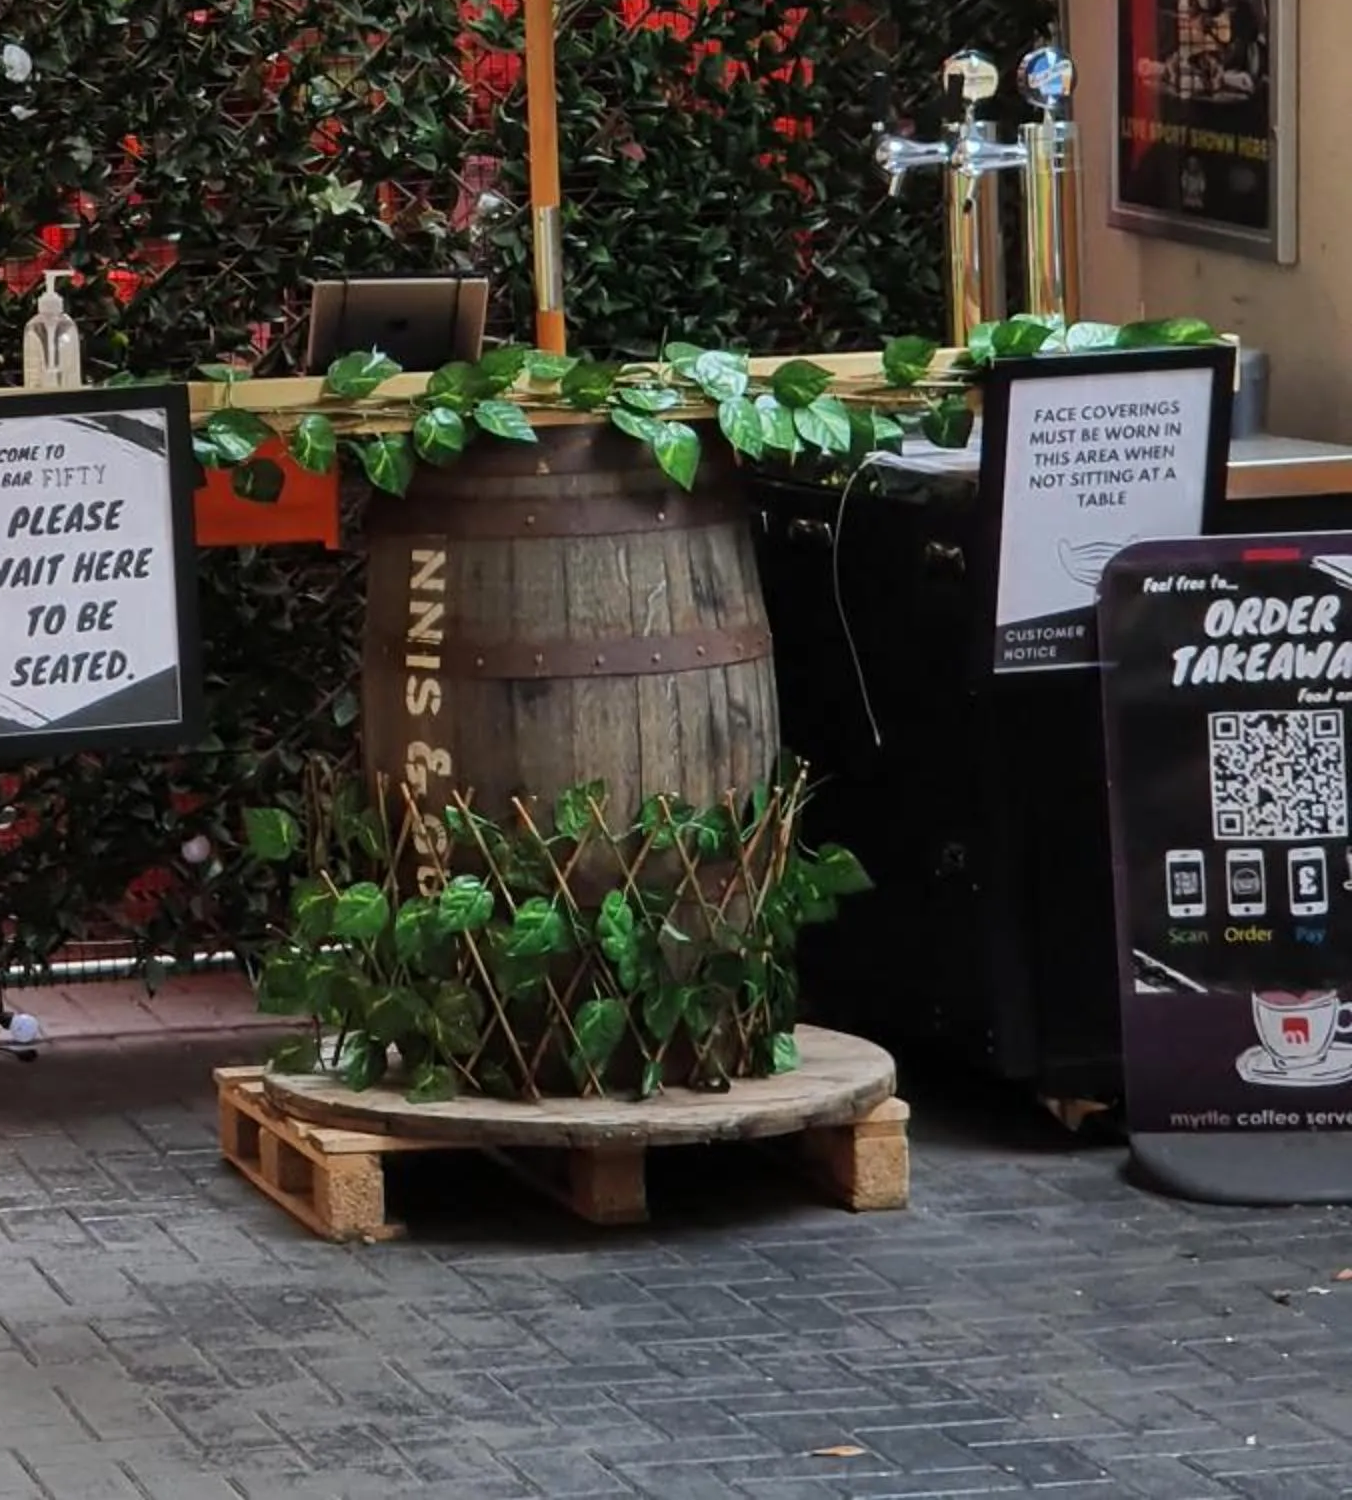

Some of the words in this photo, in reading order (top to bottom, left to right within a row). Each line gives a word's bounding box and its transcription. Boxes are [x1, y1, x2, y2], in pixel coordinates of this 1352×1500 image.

[1034, 407, 1078, 423] FACE
[1081, 400, 1181, 420] COVERINGS
[1029, 429, 1076, 446] MUST
[1081, 428, 1100, 442] BE
[1104, 424, 1160, 441] WORN
[1165, 422, 1182, 437] IN
[45, 444, 65, 460] TO
[1034, 451, 1070, 467] THIS
[1074, 448, 1120, 465] AREA
[1123, 444, 1175, 461] WHEN
[1, 471, 33, 488] BAR
[41, 464, 107, 489] FIFTY
[1029, 473, 1066, 490] NOT
[1070, 468, 1134, 487] SITTING
[1138, 467, 1161, 482] AT
[1164, 467, 1177, 480] A
[1077, 490, 1128, 508] TABLE
[7, 499, 124, 538] PLEASE
[72, 547, 153, 584] HERE
[27, 604, 67, 637] TO
[76, 600, 118, 633] BE
[1203, 594, 1341, 638] ORDER
[1005, 625, 1087, 643] CUSTOMER
[1003, 645, 1058, 661] NOTICE
[10, 649, 135, 688] SEATED.
[1168, 927, 1209, 943] Scan
[1224, 926, 1273, 943] Order
[1296, 926, 1325, 944] Pay
[1170, 1110, 1231, 1130] myrtle
[1236, 1109, 1300, 1126] coffee
